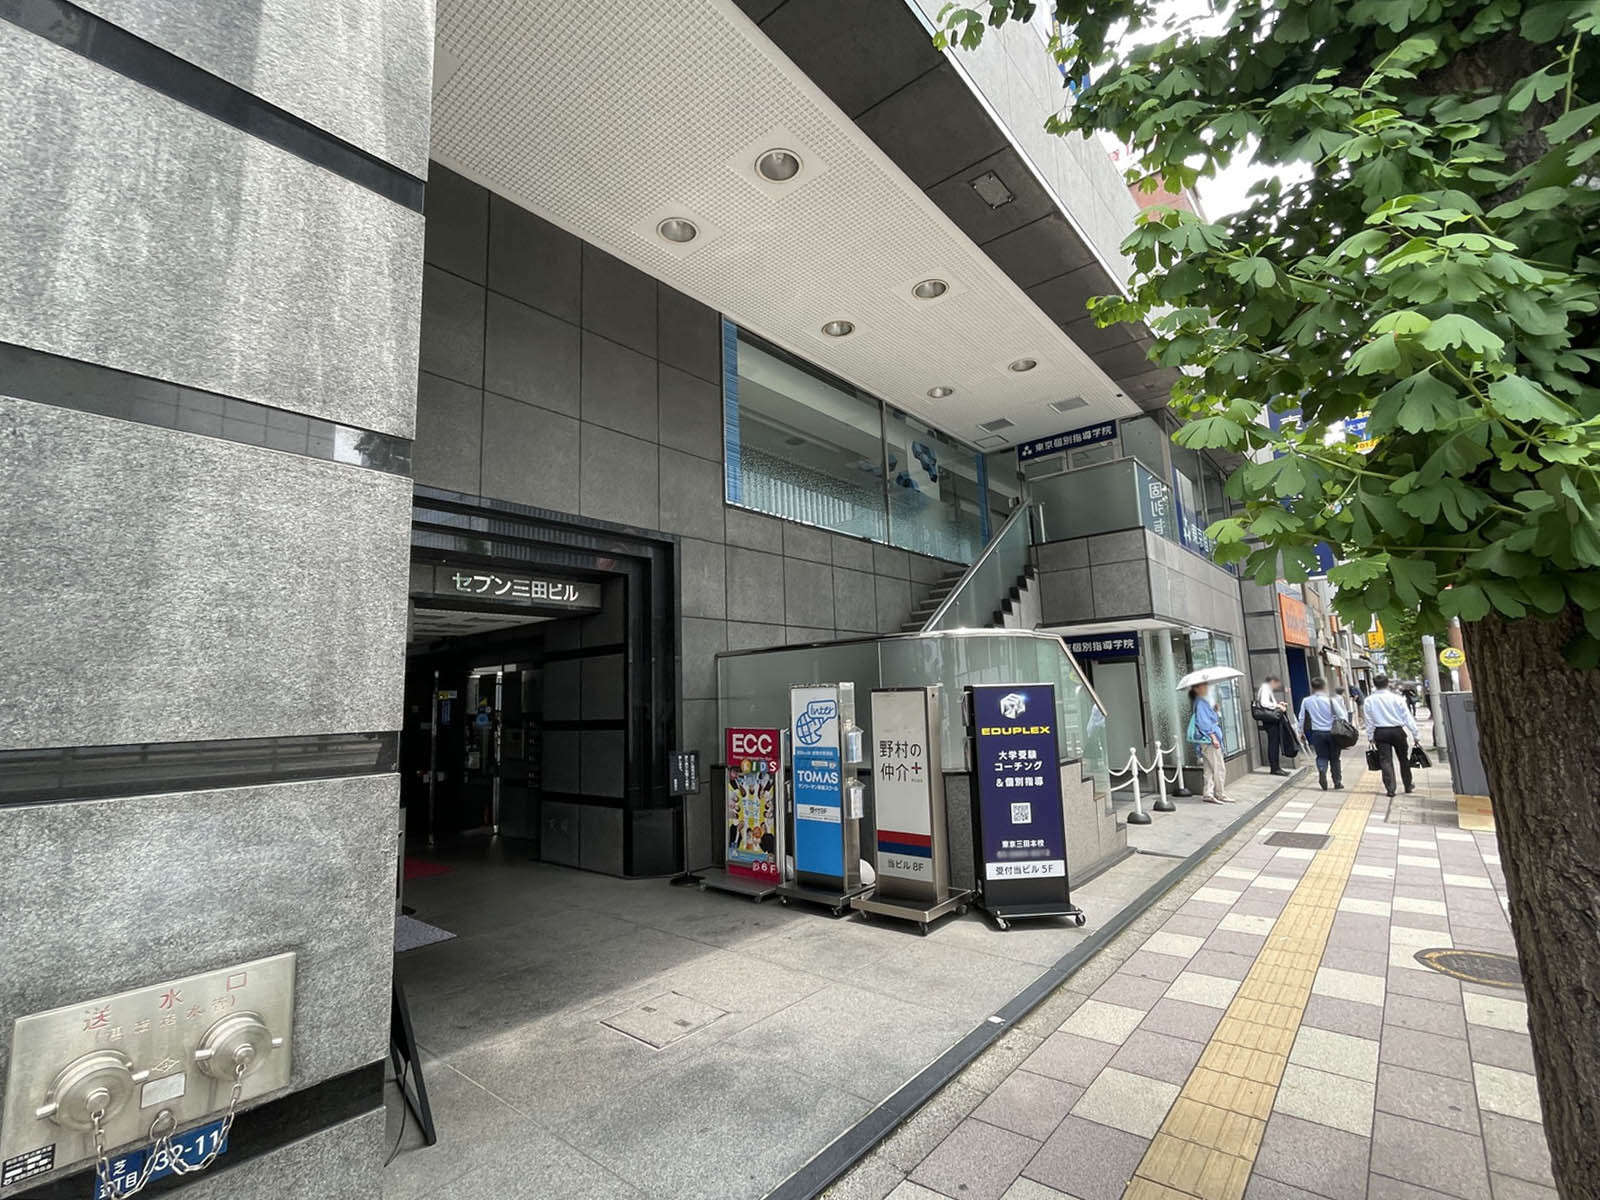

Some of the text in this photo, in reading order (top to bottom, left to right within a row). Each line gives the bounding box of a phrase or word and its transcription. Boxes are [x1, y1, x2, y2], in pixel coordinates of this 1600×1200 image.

[1035, 426, 1113, 452] 東京個別指導学院
[452, 572, 579, 602] セブン三田ビル
[981, 726, 1050, 736] EDUPLEX
[732, 733, 772, 755] ECC
[879, 740, 922, 759] 野村の
[998, 749, 1037, 761] 大学受験
[994, 760, 1043, 772] コーチング
[797, 770, 839, 784] TOMAS
[1001, 839, 1045, 849] 東京三田本校
[113, 1159, 127, 1176] 芝
